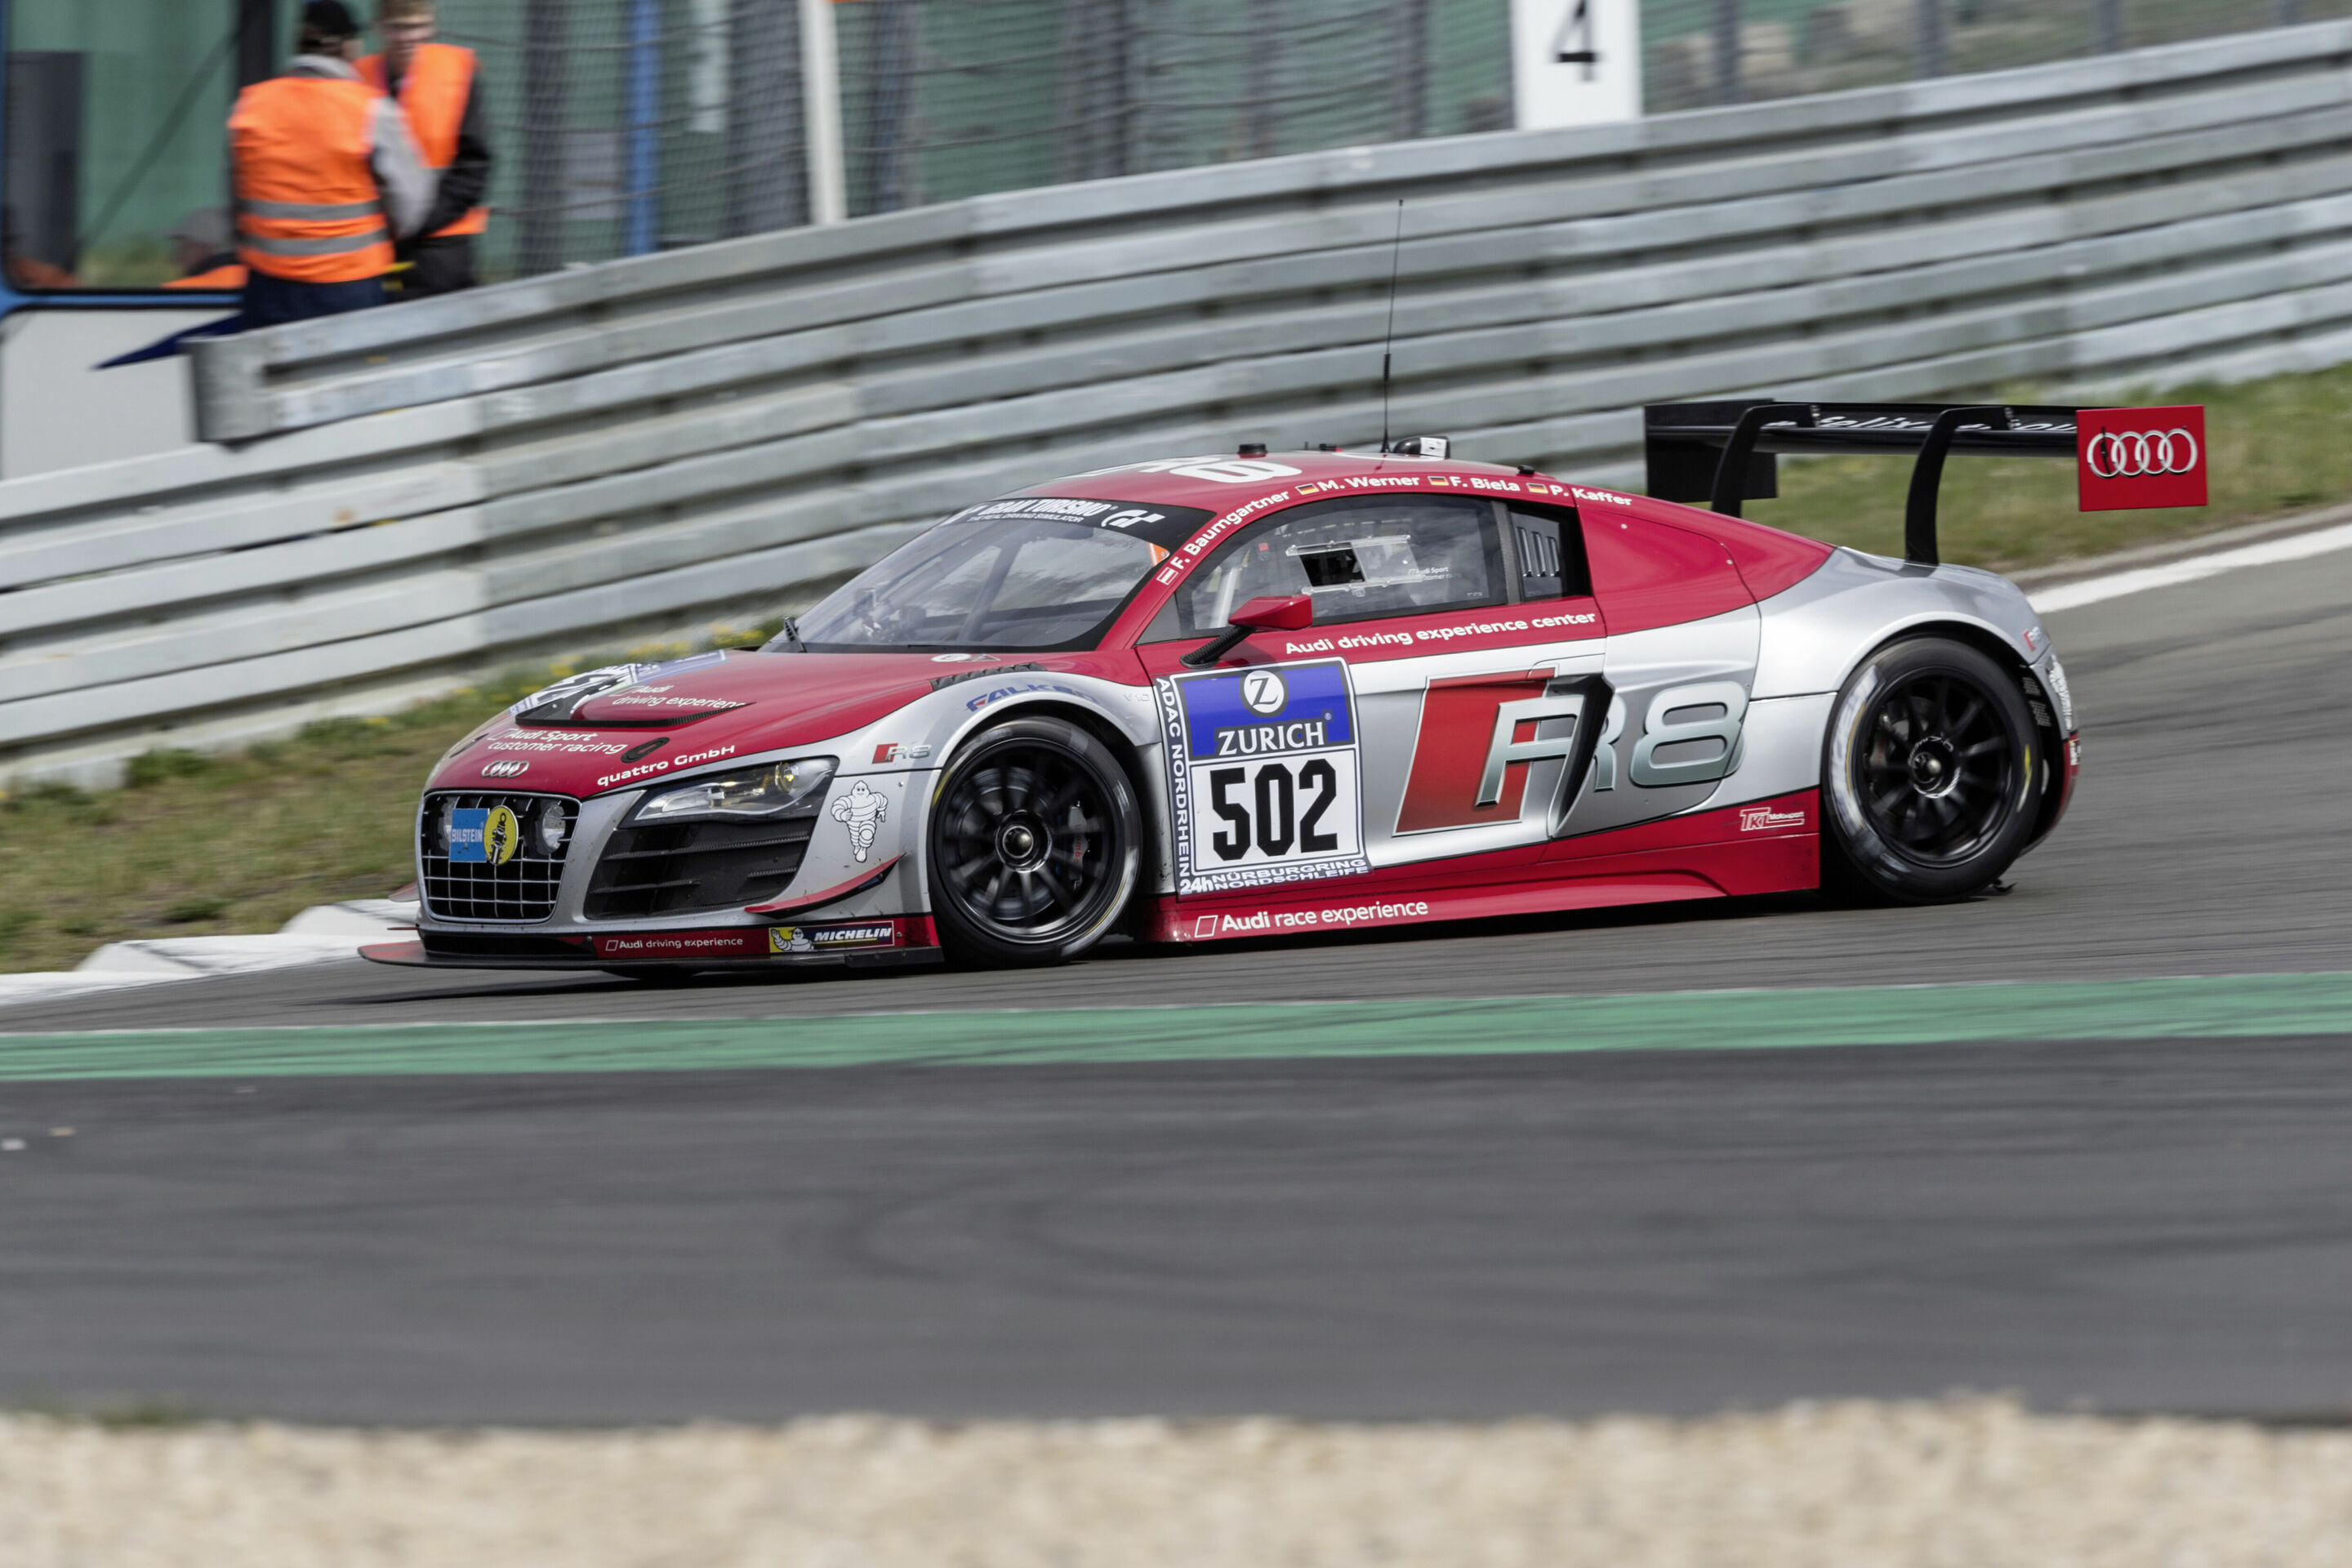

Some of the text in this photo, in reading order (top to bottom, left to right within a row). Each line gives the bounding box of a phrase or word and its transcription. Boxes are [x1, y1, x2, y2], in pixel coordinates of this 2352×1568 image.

[1552, 0, 1600, 81] 4
[1316, 476, 1420, 491] M. Werner
[1449, 476, 1521, 492] F. Biela
[1549, 484, 1633, 506] P. Kaffer
[1034, 513, 1085, 523] SIMULATOR
[1169, 491, 1290, 570] F. Baumgartner
[1285, 612, 1596, 655] Audi driving experience center
[612, 695, 746, 709] driving experien
[504, 729, 599, 742] Audi Sport
[1217, 721, 1325, 756] ZURICH
[1474, 681, 1749, 807] R8
[488, 741, 628, 755] customer racing
[884, 744, 932, 762] R8
[596, 745, 736, 786] quattro GmbH
[1156, 677, 1191, 877] ADAC NORDRHEIN
[1209, 758, 1339, 862] 502
[451, 828, 483, 843] BILSTEIN
[1212, 858, 1367, 883] NÜRBURGRING
[1214, 866, 1370, 890] NORDSCHLEIFE
[1179, 876, 1214, 893] 24h
[1221, 901, 1429, 932] Audi race experience
[618, 937, 743, 951] Audi driving experience
[813, 927, 892, 942] MICHELIN
